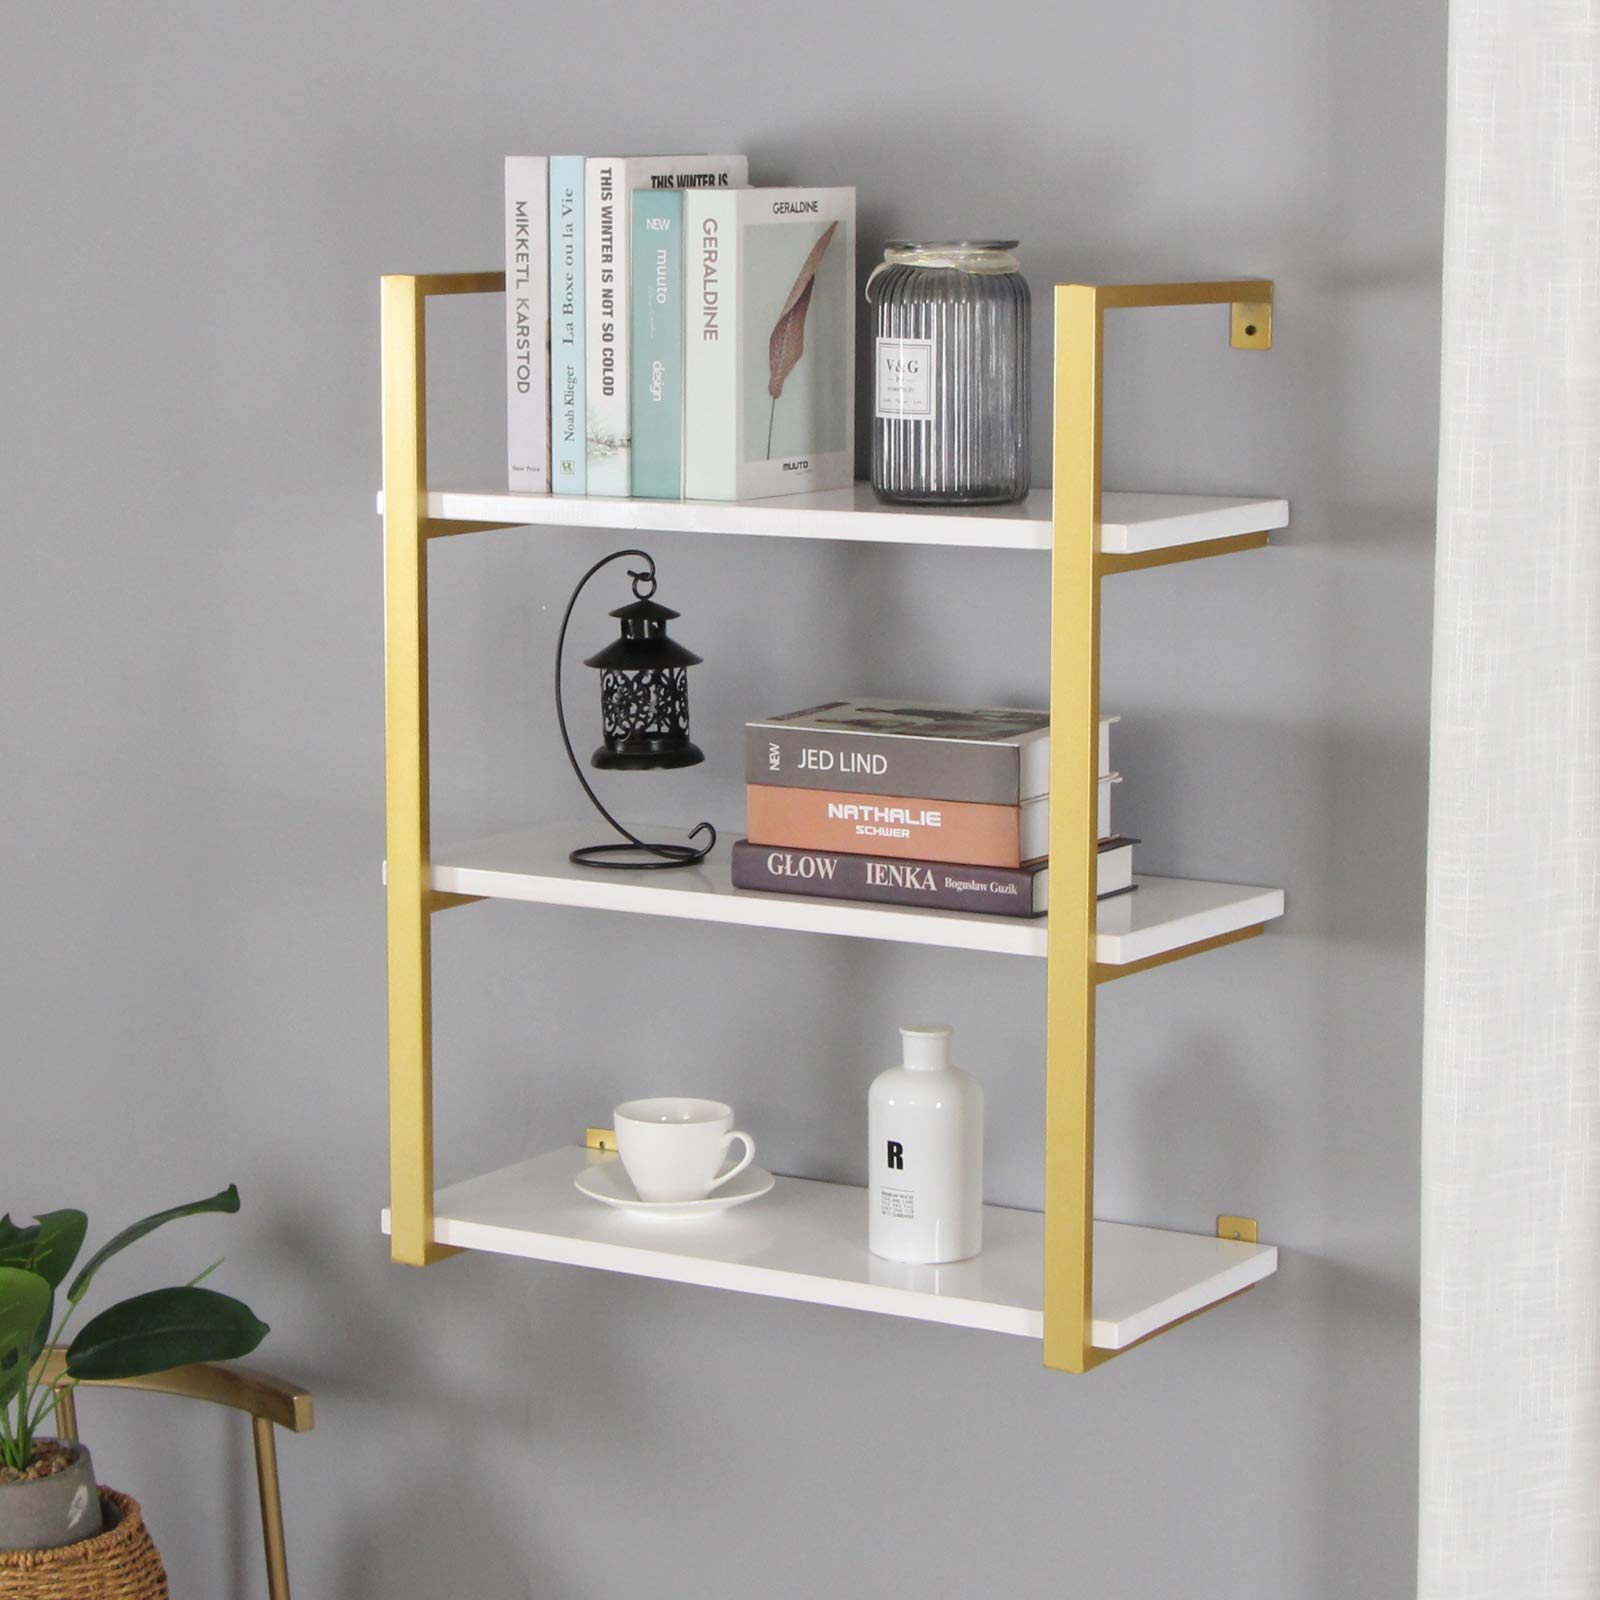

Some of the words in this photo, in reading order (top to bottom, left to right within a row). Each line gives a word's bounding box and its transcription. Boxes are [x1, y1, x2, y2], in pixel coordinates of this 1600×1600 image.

[600, 167, 613, 201] THIS
[651, 175, 674, 189] THIS
[676, 173, 715, 188] WINTER
[718, 172, 728, 186] IS
[561, 187, 573, 217] Vie
[772, 201, 818, 215] GERALDINE
[562, 223, 574, 238] la
[601, 205, 613, 263] WINTER
[646, 218, 670, 231] NEW
[515, 201, 529, 290] MIKKETL
[565, 244, 574, 266] ou
[602, 269, 614, 283] IS
[656, 249, 668, 304] muuto
[703, 218, 718, 341] GERALDINE
[562, 272, 574, 315] Boxe
[602, 288, 614, 318] NOT
[516, 297, 530, 394] KARSTOD
[563, 321, 574, 345] La
[602, 322, 614, 343] SO
[564, 365, 577, 405] Klieger
[602, 347, 615, 396] COLOD
[650, 361, 664, 401] design
[564, 410, 575, 441] Noah
[769, 742, 781, 771] NEW
[797, 748, 835, 770] JED
[839, 751, 888, 775] LIND
[828, 803, 942, 827] NATHALIE
[855, 825, 910, 838] SCHWER
[865, 862, 938, 891] IENKA
[989, 881, 1018, 896] Guzik
[887, 1140, 904, 1171] R
